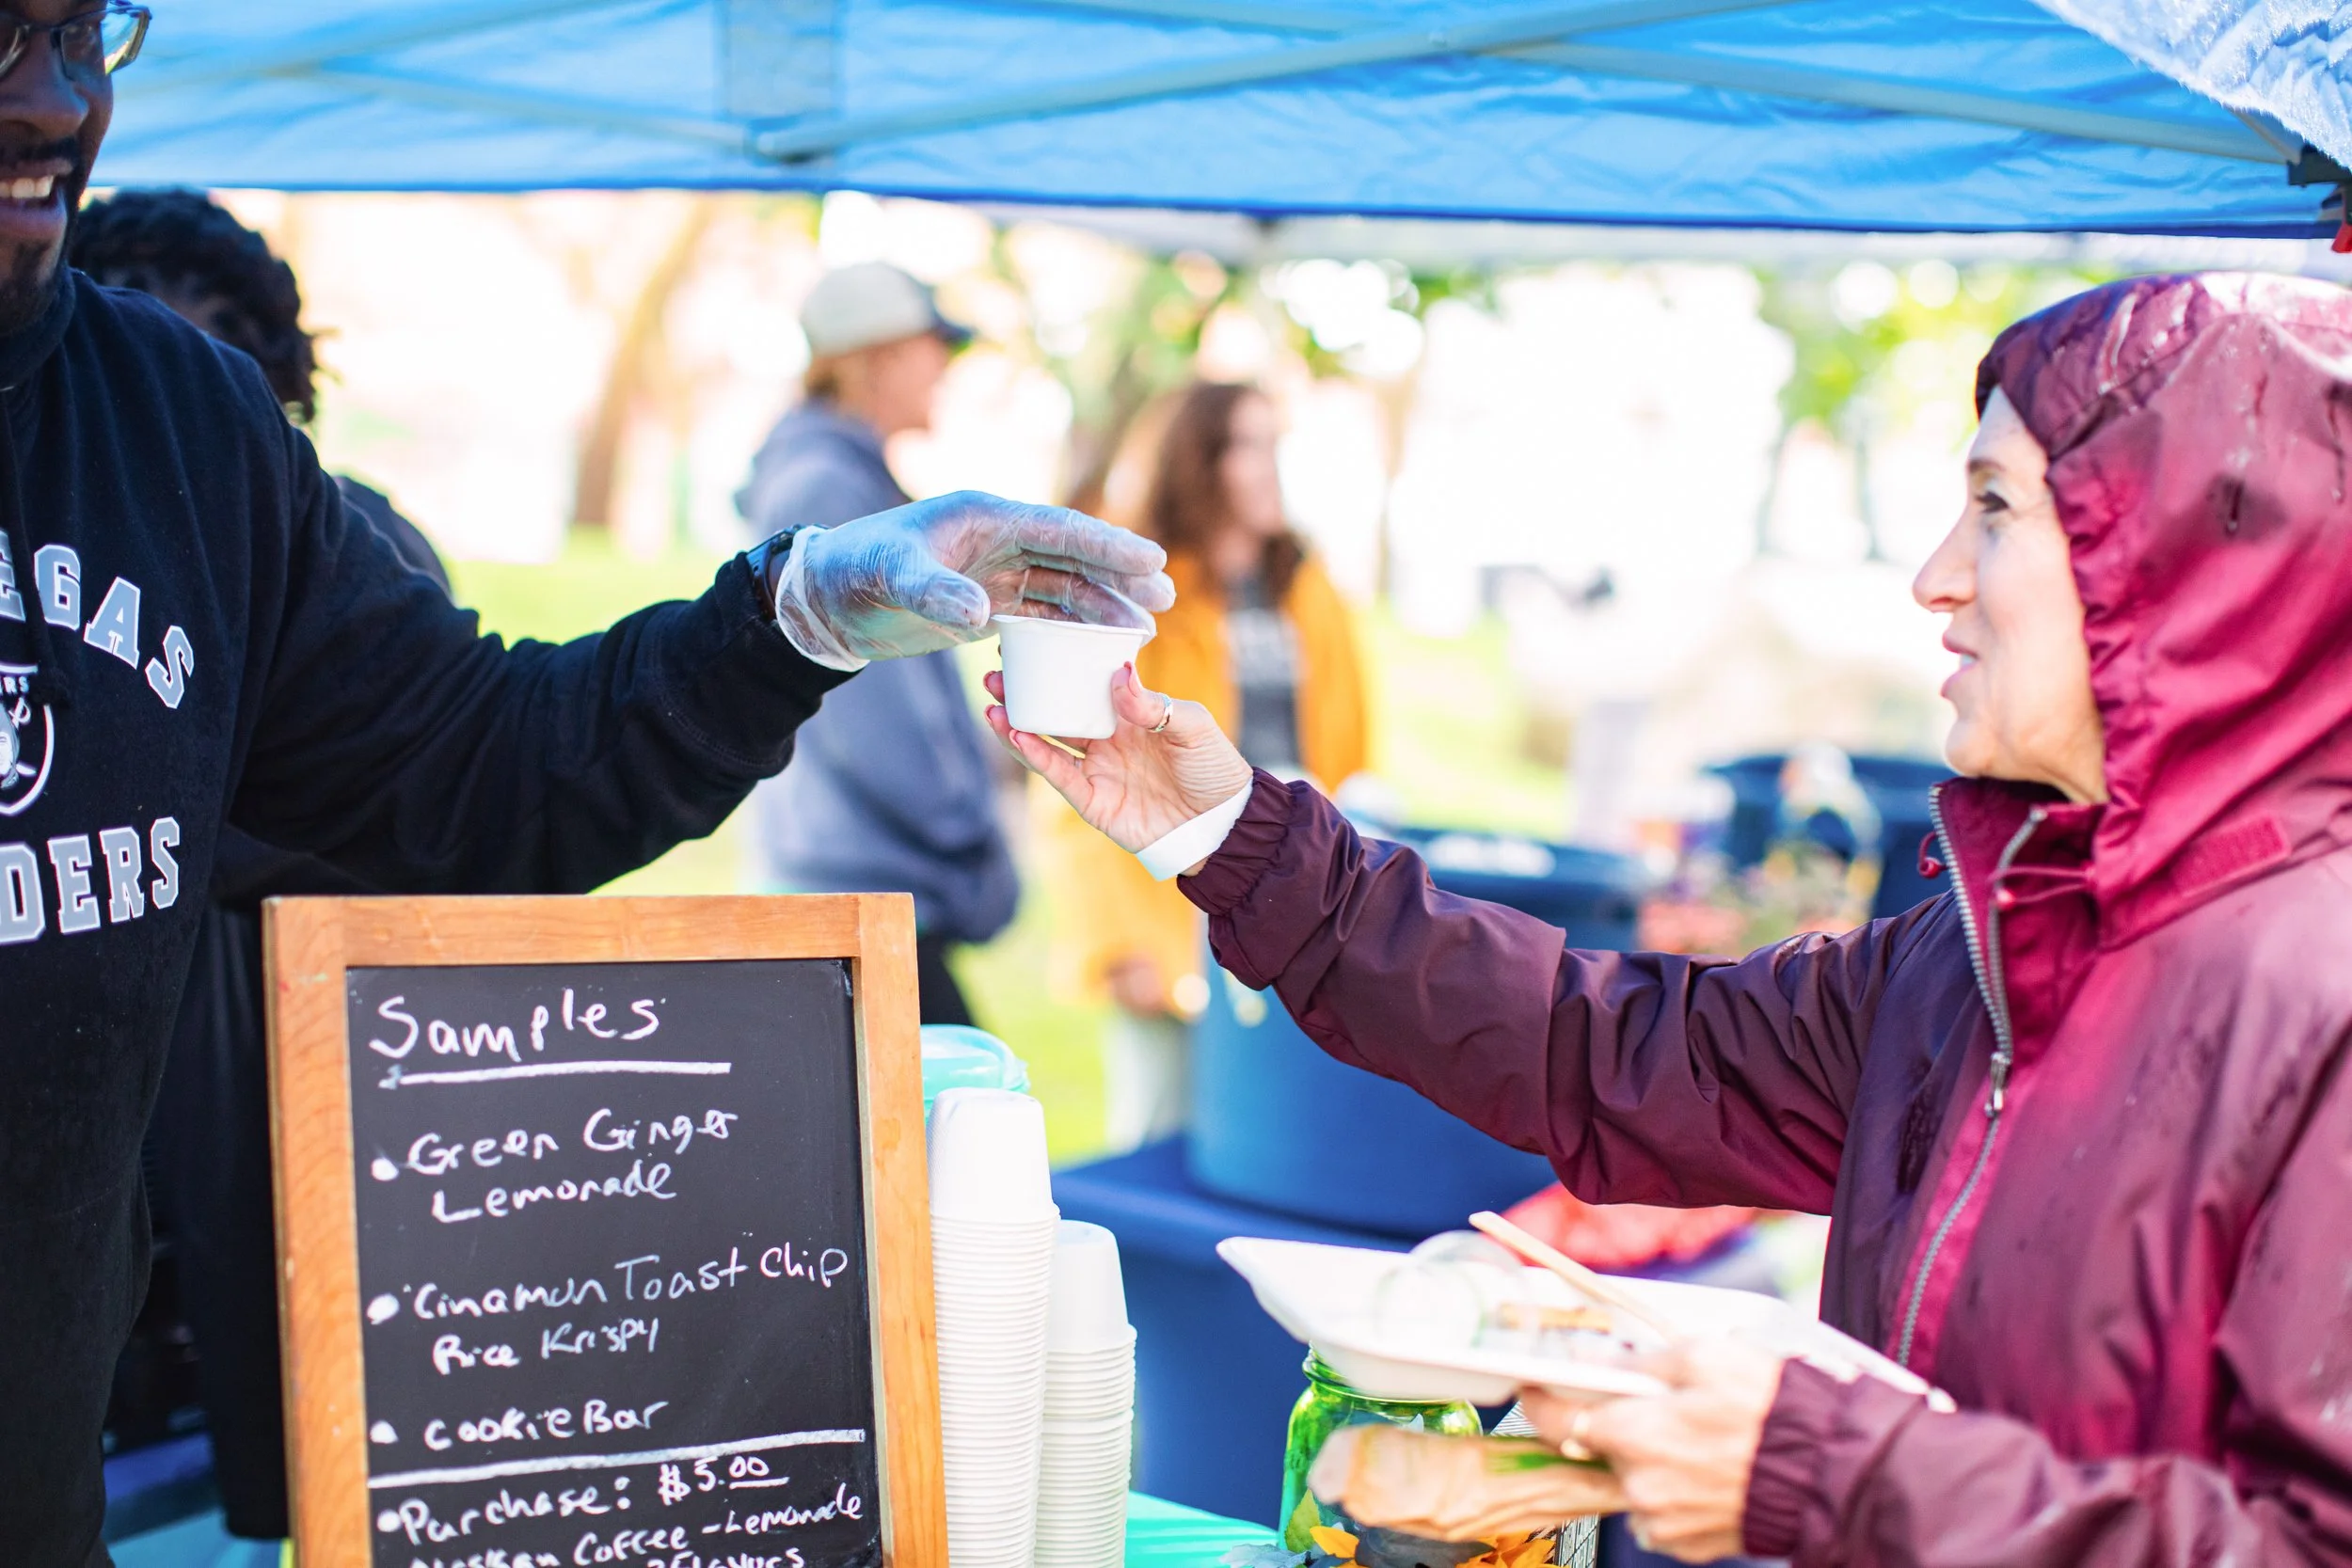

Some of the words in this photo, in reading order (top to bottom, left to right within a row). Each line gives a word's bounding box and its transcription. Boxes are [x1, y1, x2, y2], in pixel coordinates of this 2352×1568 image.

[0, 816, 180, 942] DERS
[368, 988, 660, 1063] Samples
[403, 1131, 560, 1177] Green
[582, 1107, 739, 1155] Ginger
[431, 1158, 677, 1224] Lemonade
[614, 1246, 749, 1301] Toast
[433, 1334, 520, 1375] Rice
[541, 1317, 659, 1359] Krispy
[583, 1399, 669, 1434] Bar
[658, 1455, 771, 1506] $5.00
[573, 1528, 689, 1566] Coffee
